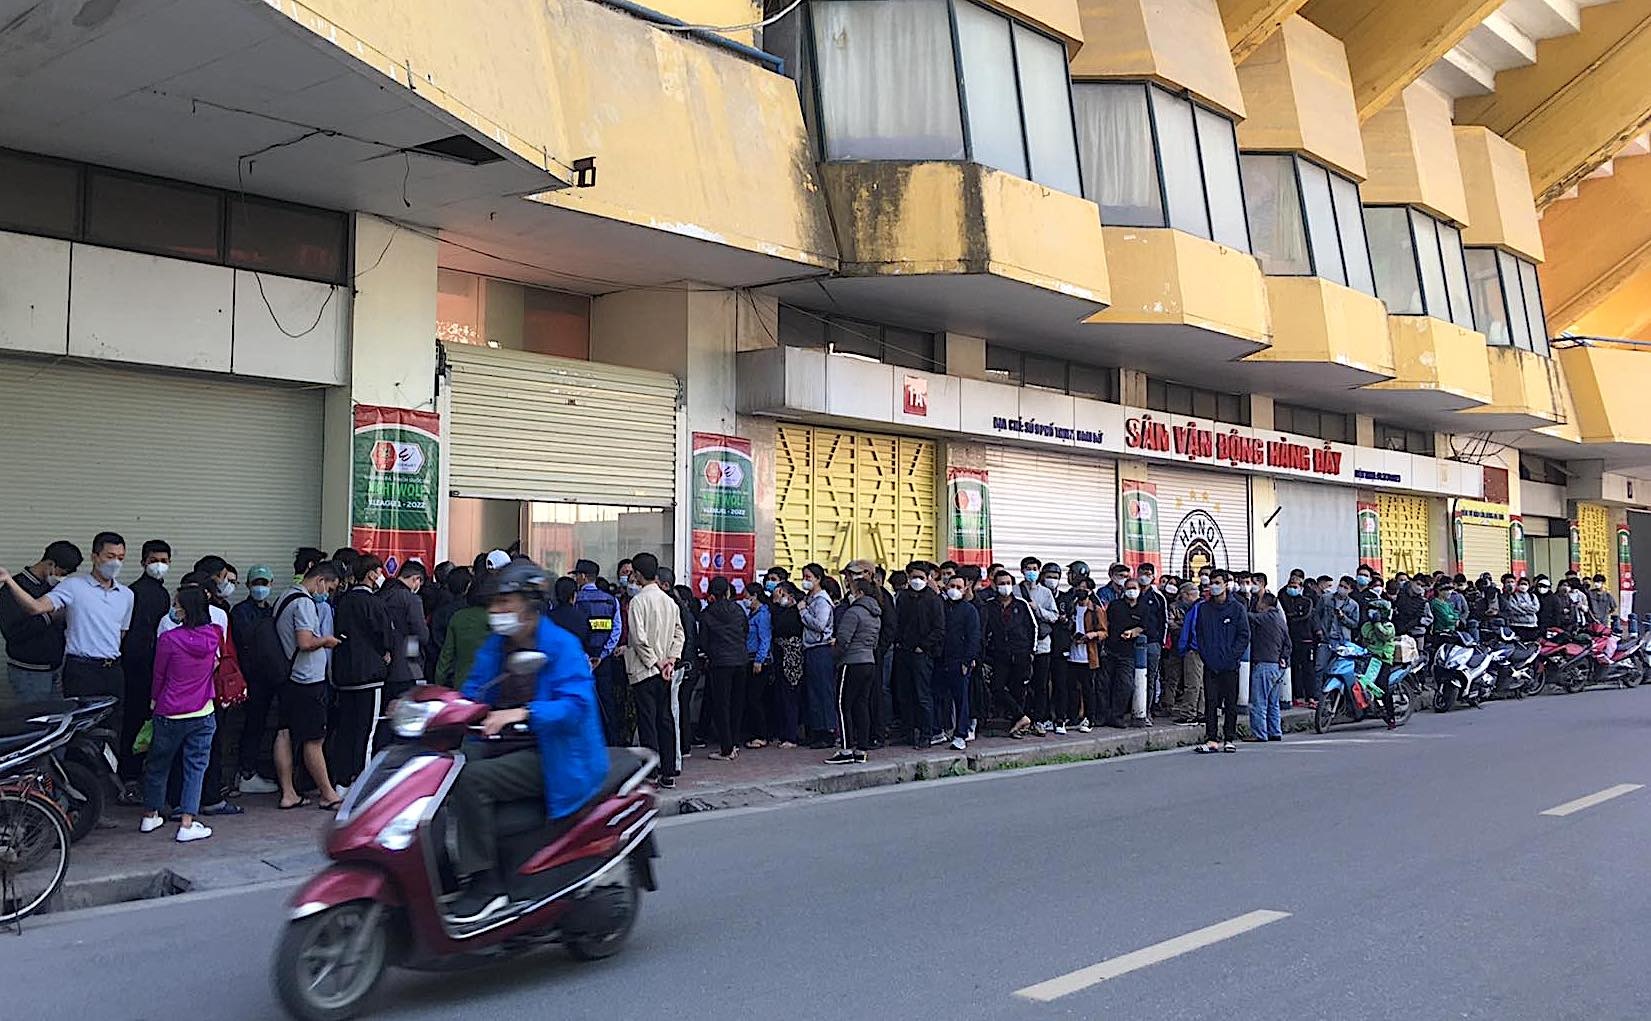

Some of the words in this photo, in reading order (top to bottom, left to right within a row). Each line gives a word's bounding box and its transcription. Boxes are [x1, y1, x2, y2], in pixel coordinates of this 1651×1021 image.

[1126, 414, 1170, 451] SÂN
[1172, 421, 1213, 460] VẬN
[1216, 428, 1264, 466] ĐỘNG
[1267, 436, 1310, 471] HÀNG
[1180, 519, 1219, 549] HANOI
